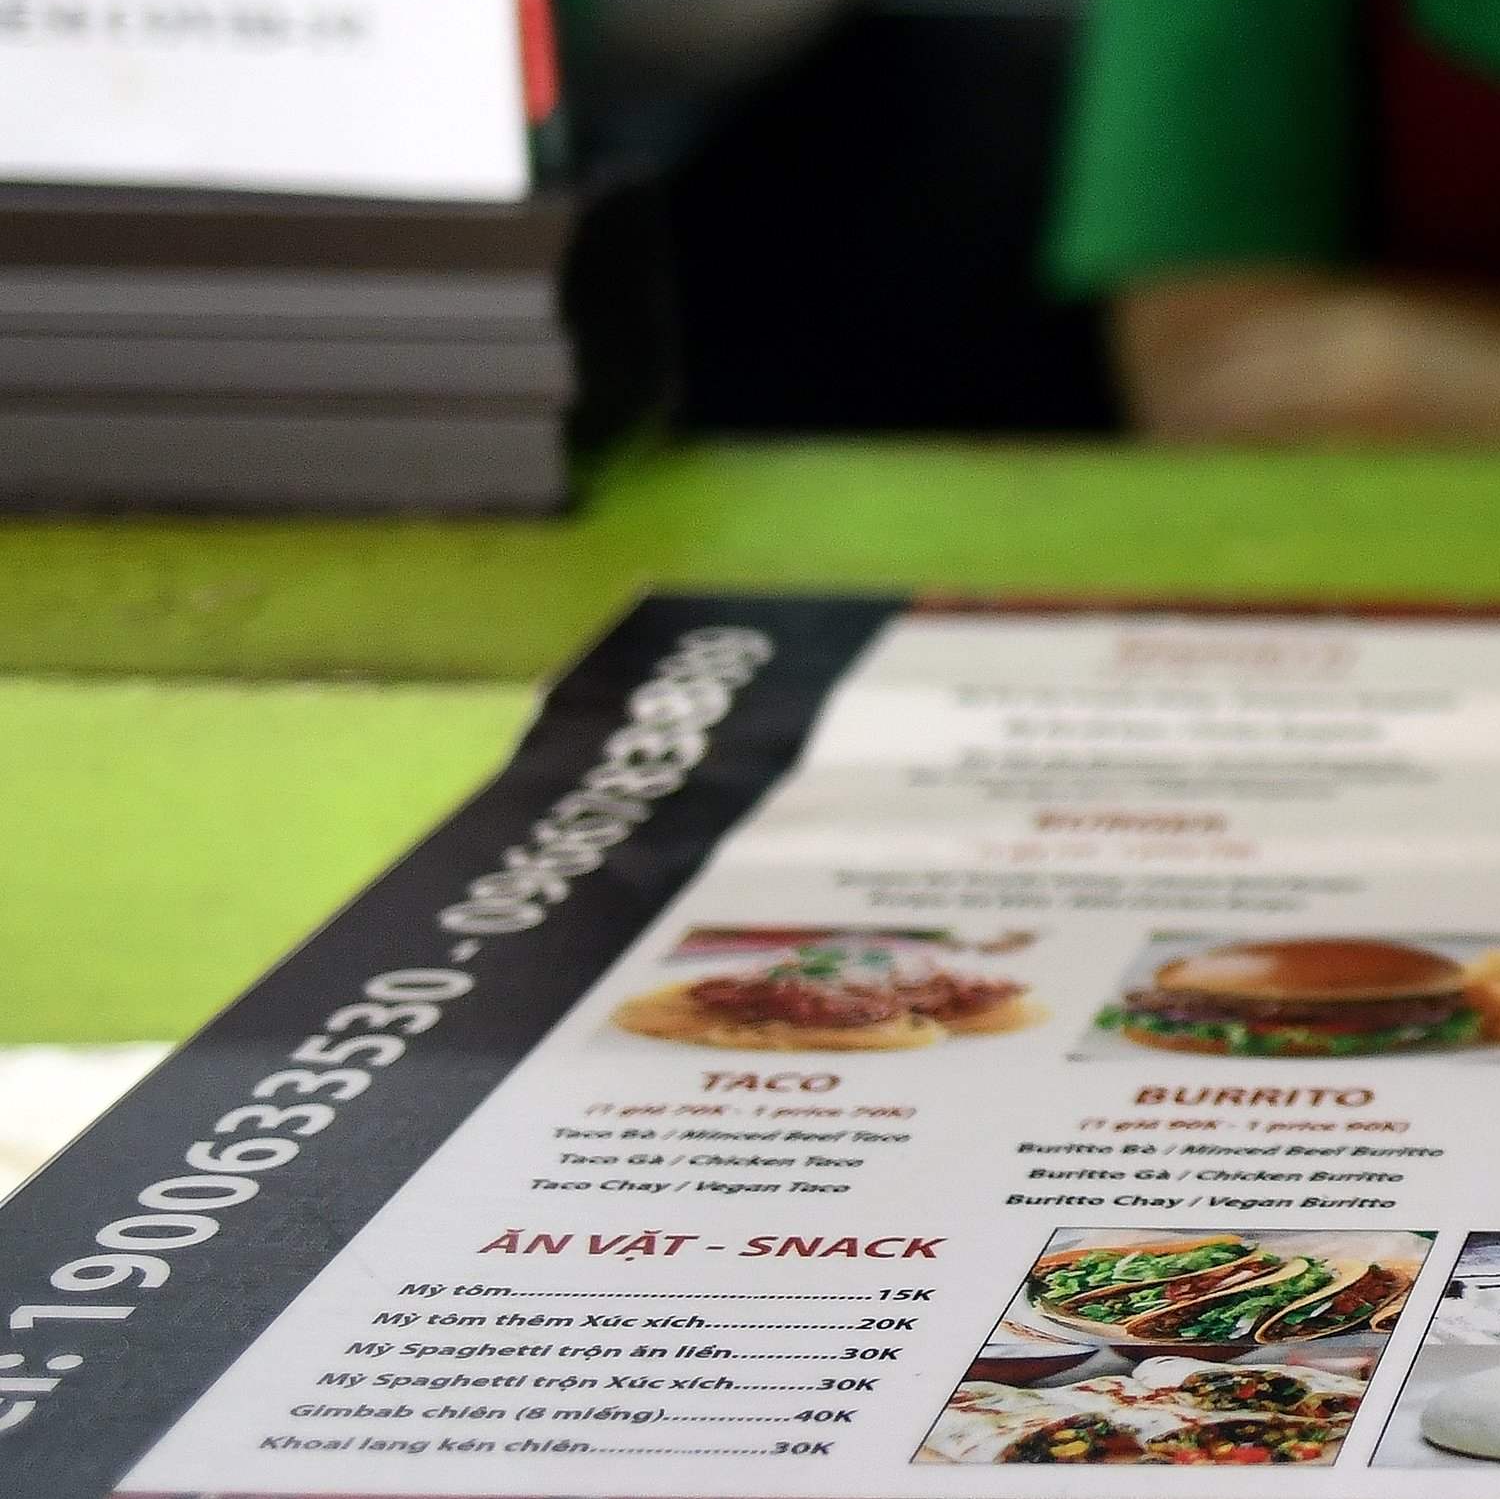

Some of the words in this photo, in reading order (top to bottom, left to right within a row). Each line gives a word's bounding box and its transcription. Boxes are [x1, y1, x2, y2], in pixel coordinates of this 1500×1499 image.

[701, 1072, 842, 1093] TACO
[1134, 1086, 1376, 1108] BURRITO
[9, 968, 476, 1330] 1900633530
[558, 1153, 619, 1166] Taco
[688, 1154, 796, 1169] Chicken
[803, 1156, 865, 1169] Taco
[1196, 1169, 1304, 1184] Chicken
[529, 1179, 592, 1192] Taco
[599, 1179, 671, 1195] Chay
[695, 1180, 782, 1196] Vegan
[787, 1181, 851, 1194] Taco
[1112, 1194, 1184, 1209] Chay
[1208, 1195, 1296, 1211] Vegan
[478, 1229, 575, 1256] ĂN
[738, 1236, 948, 1259] SNACK
[877, 1288, 937, 1301] 15K
[427, 1313, 488, 1326] tôm
[495, 1314, 574, 1327] thêm
[579, 1315, 639, 1328] Xúc
[855, 1317, 919, 1331] 20K
[399, 1342, 554, 1359] Spaghetti
[558, 1345, 622, 1361] trộn
[629, 1345, 669, 1358] ăn
[839, 1347, 904, 1361] 30K
[372, 1373, 529, 1389] Spaghetti
[532, 1375, 599, 1391] trộn
[604, 1376, 667, 1389] Xúc
[815, 1378, 881, 1391] 30K
[289, 1404, 414, 1419] Gimbab
[421, 1405, 507, 1420] chiên
[514, 1406, 547, 1421] (8
[793, 1409, 858, 1423] 40K
[258, 1435, 357, 1451] Khoai
[358, 1436, 432, 1454] lang
[769, 1441, 836, 1455] 30K
